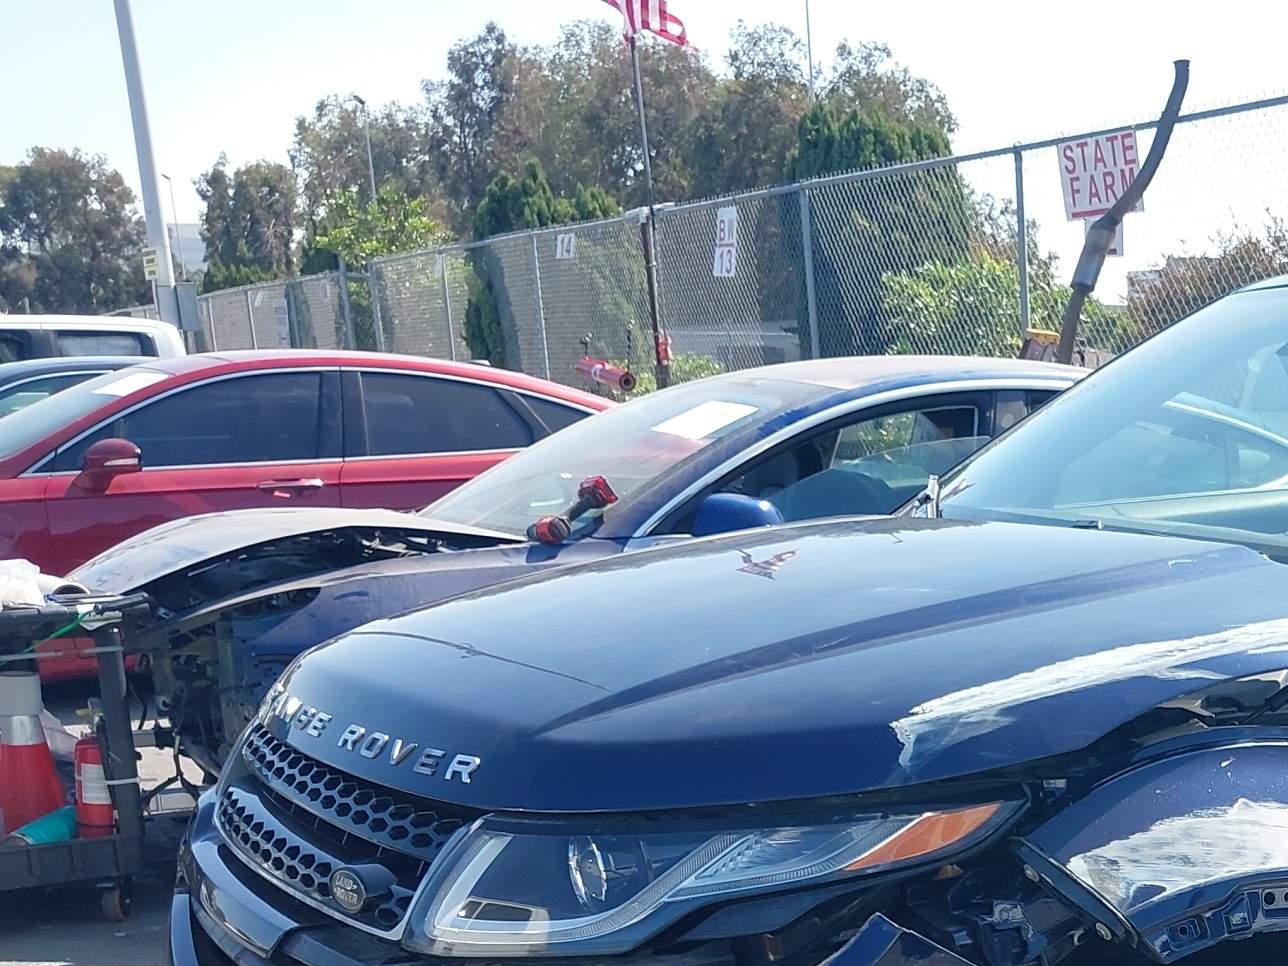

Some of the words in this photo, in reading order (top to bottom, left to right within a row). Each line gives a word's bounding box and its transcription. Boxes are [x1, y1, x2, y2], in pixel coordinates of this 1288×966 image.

[1063, 133, 1136, 174] STATE
[1070, 168, 1136, 208] FARM
[719, 250, 732, 273] 13
[337, 724, 481, 784] ROVER
